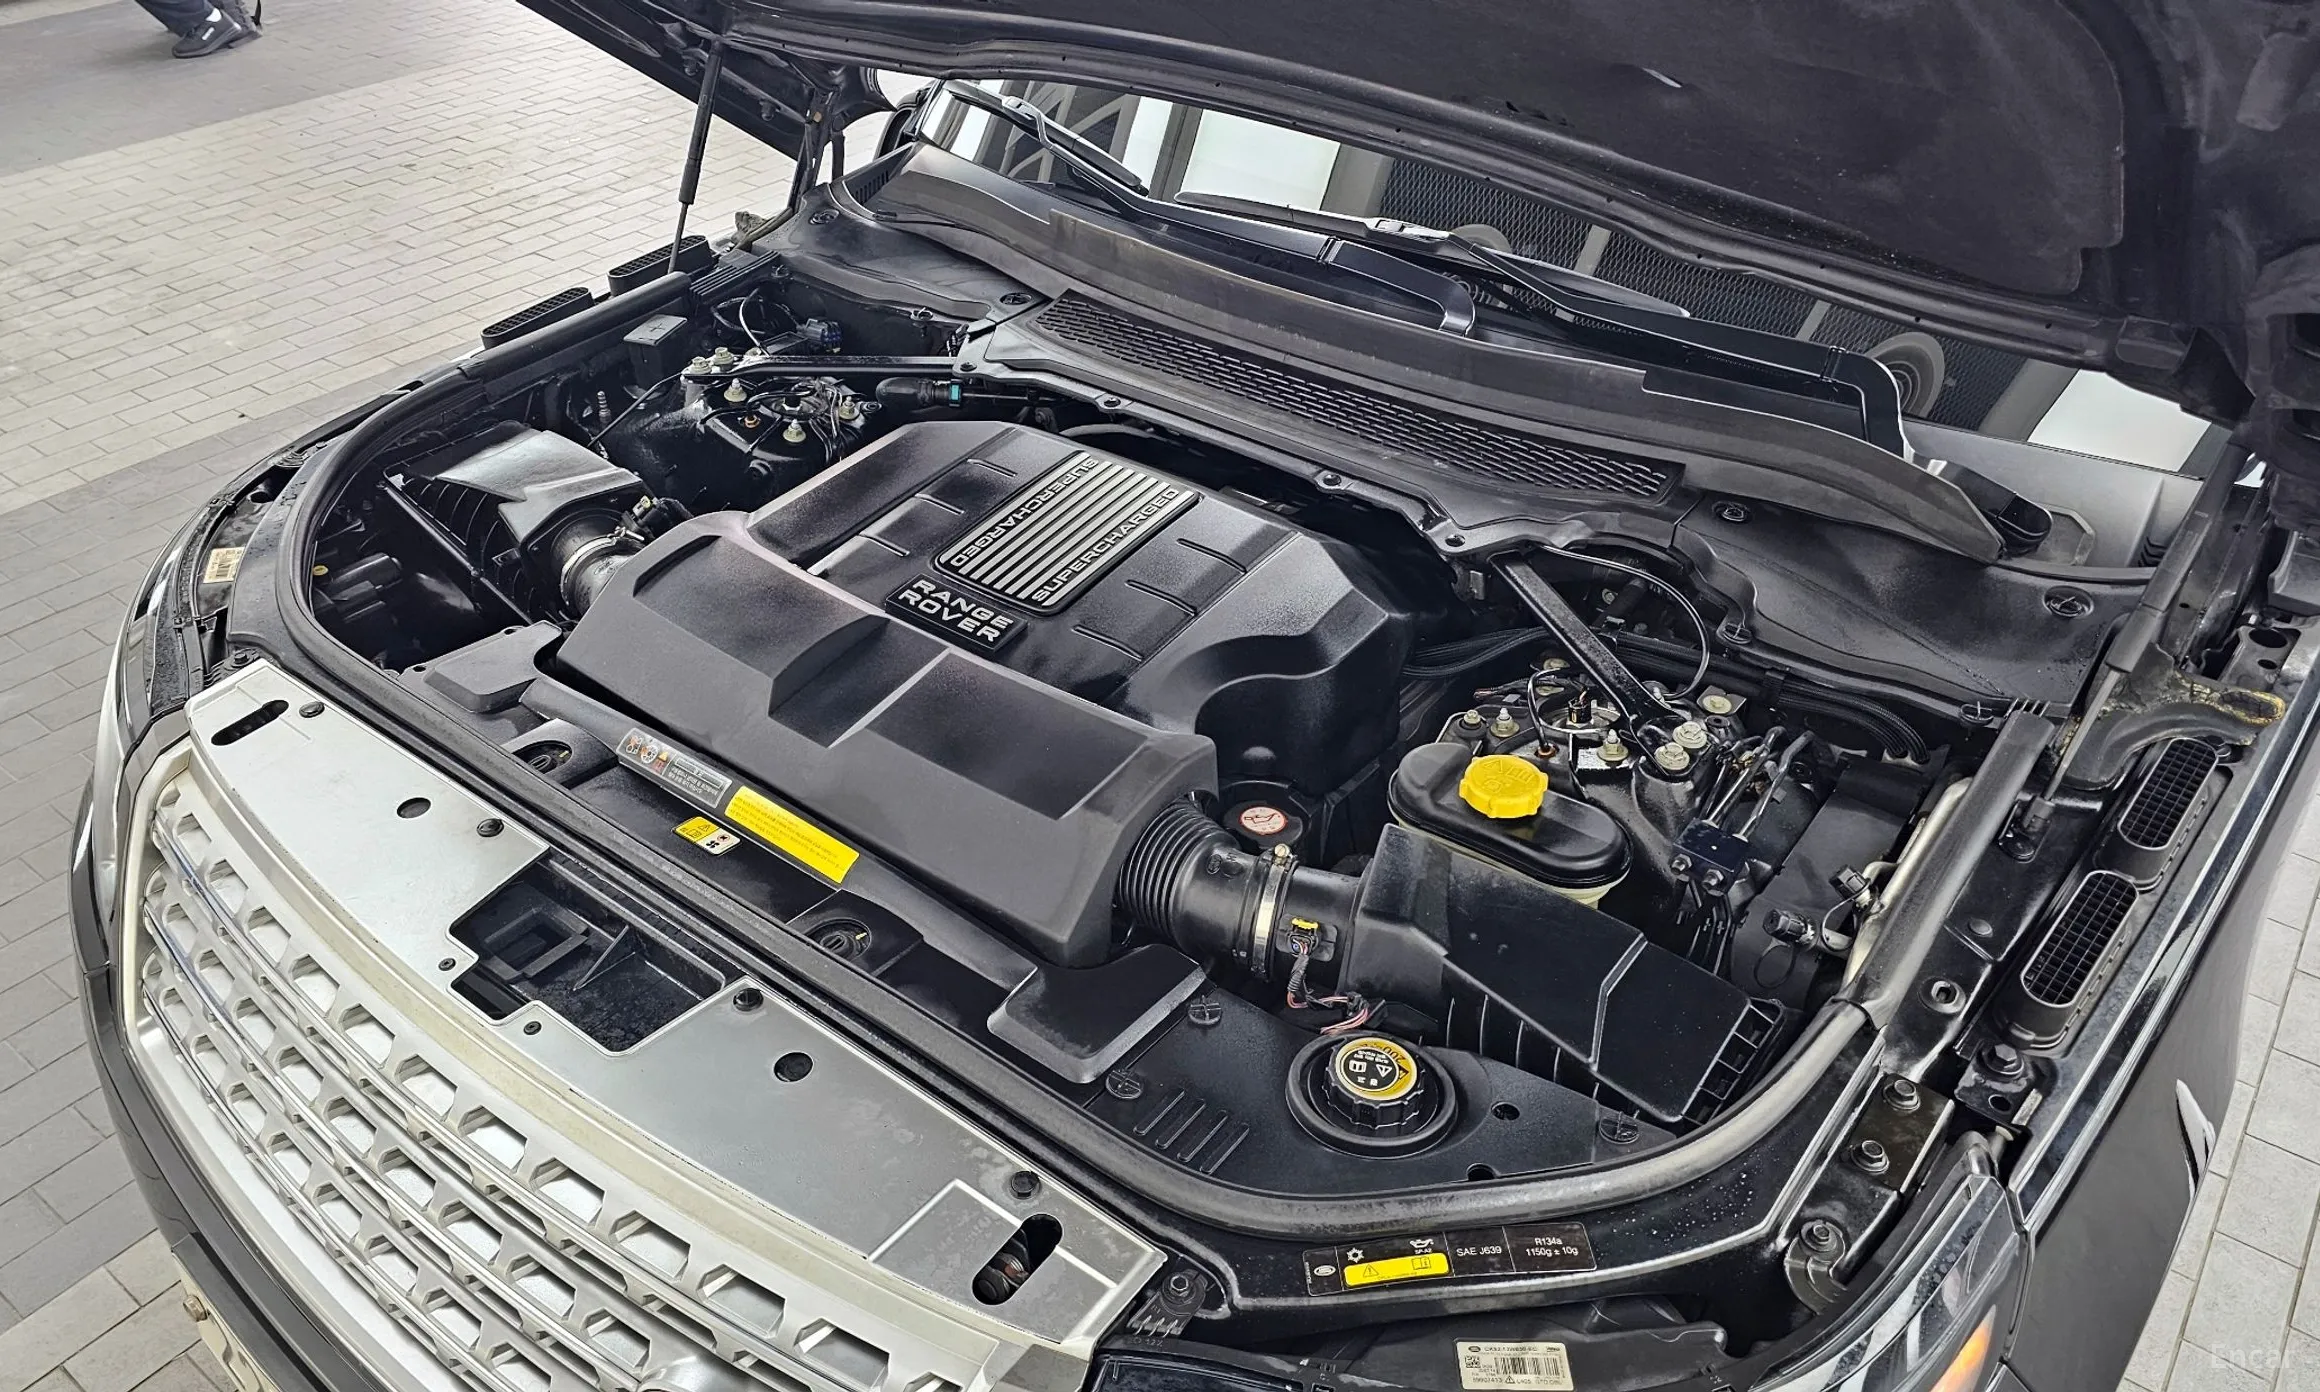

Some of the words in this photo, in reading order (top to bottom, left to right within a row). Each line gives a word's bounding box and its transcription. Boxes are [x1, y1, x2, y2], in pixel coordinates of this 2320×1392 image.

[950, 457, 1099, 567] SUPERCHARGED
[1031, 488, 1180, 602] SUPERCHARGED
[898, 590, 1002, 642] ROVER
[912, 579, 1014, 630] RANGE
[1456, 1248, 1477, 1257] SAE
[1479, 1245, 1502, 1255] J639
[1525, 1247, 1553, 1257] 1150g
[1562, 1246, 1579, 1256] 10g
[1534, 1237, 1563, 1246] R134a
